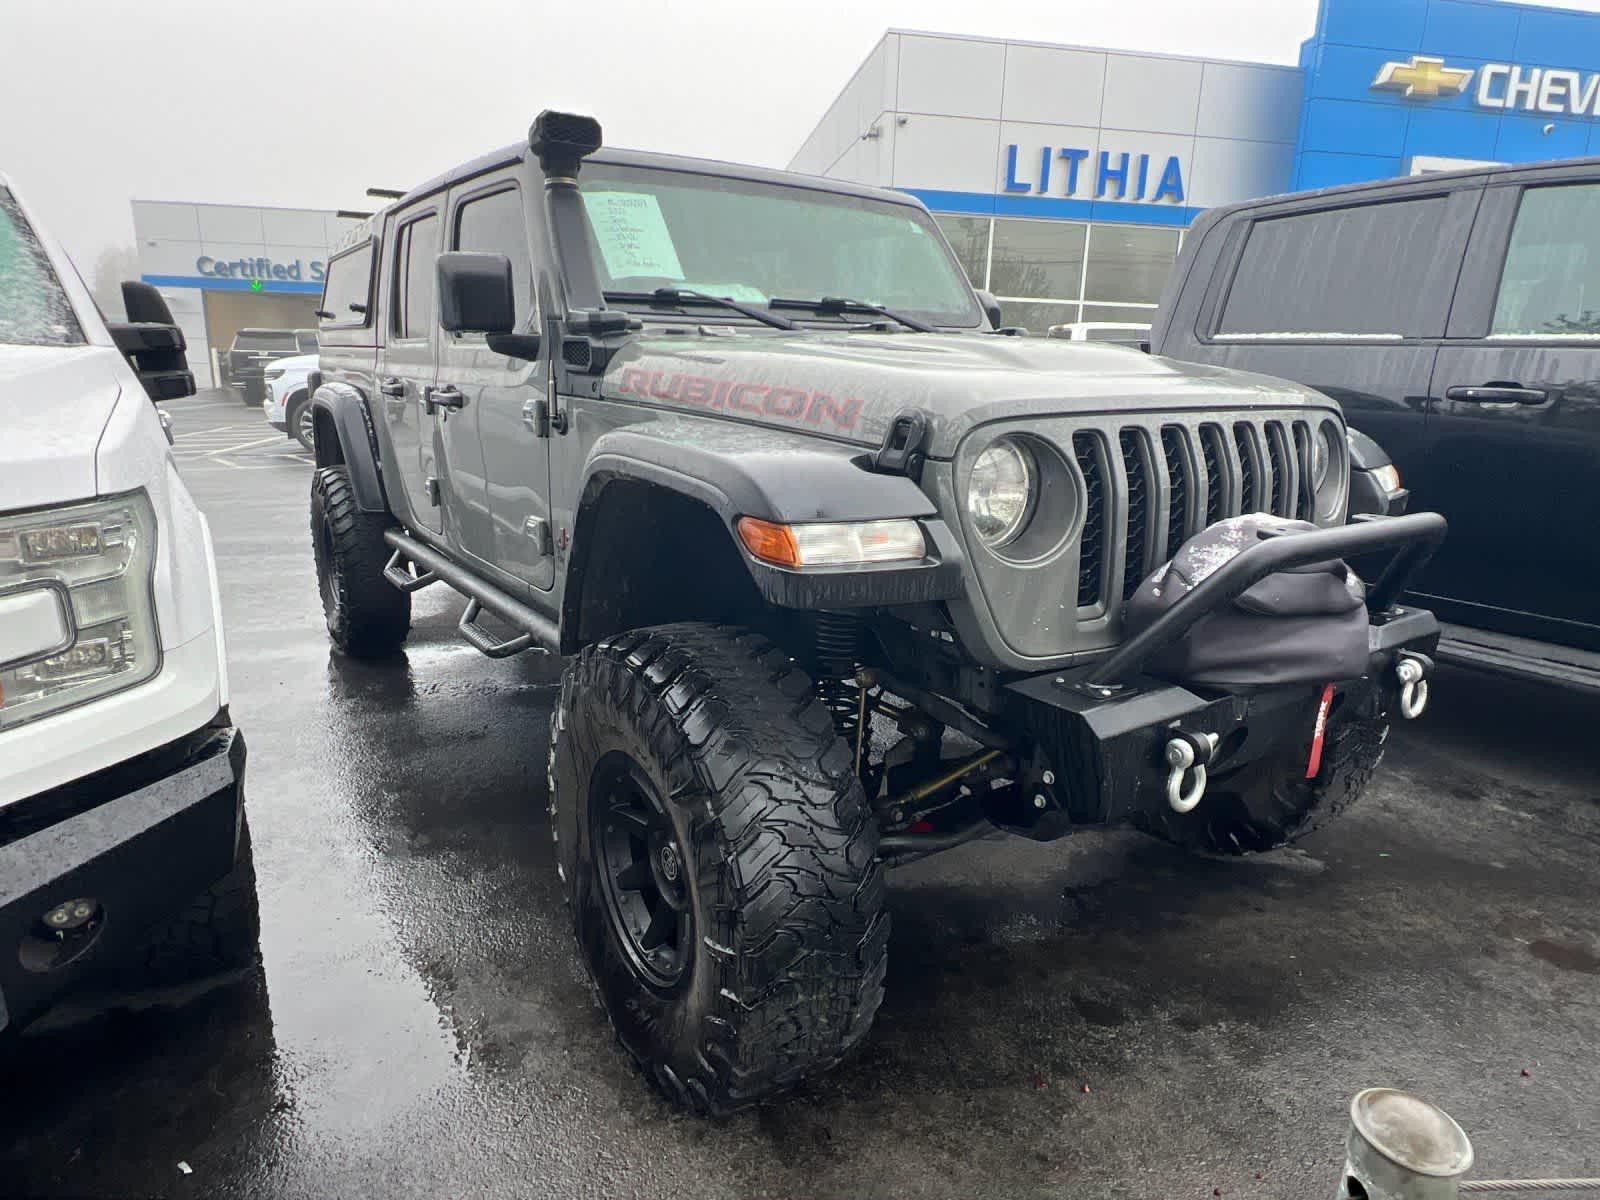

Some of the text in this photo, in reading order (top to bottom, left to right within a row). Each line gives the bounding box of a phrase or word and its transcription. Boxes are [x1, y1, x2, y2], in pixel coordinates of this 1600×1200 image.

[1477, 63, 1600, 116] CHEV
[1004, 144, 1185, 202] LITHIA
[196, 255, 302, 281] Certified
[618, 367, 866, 430] RUBICON
